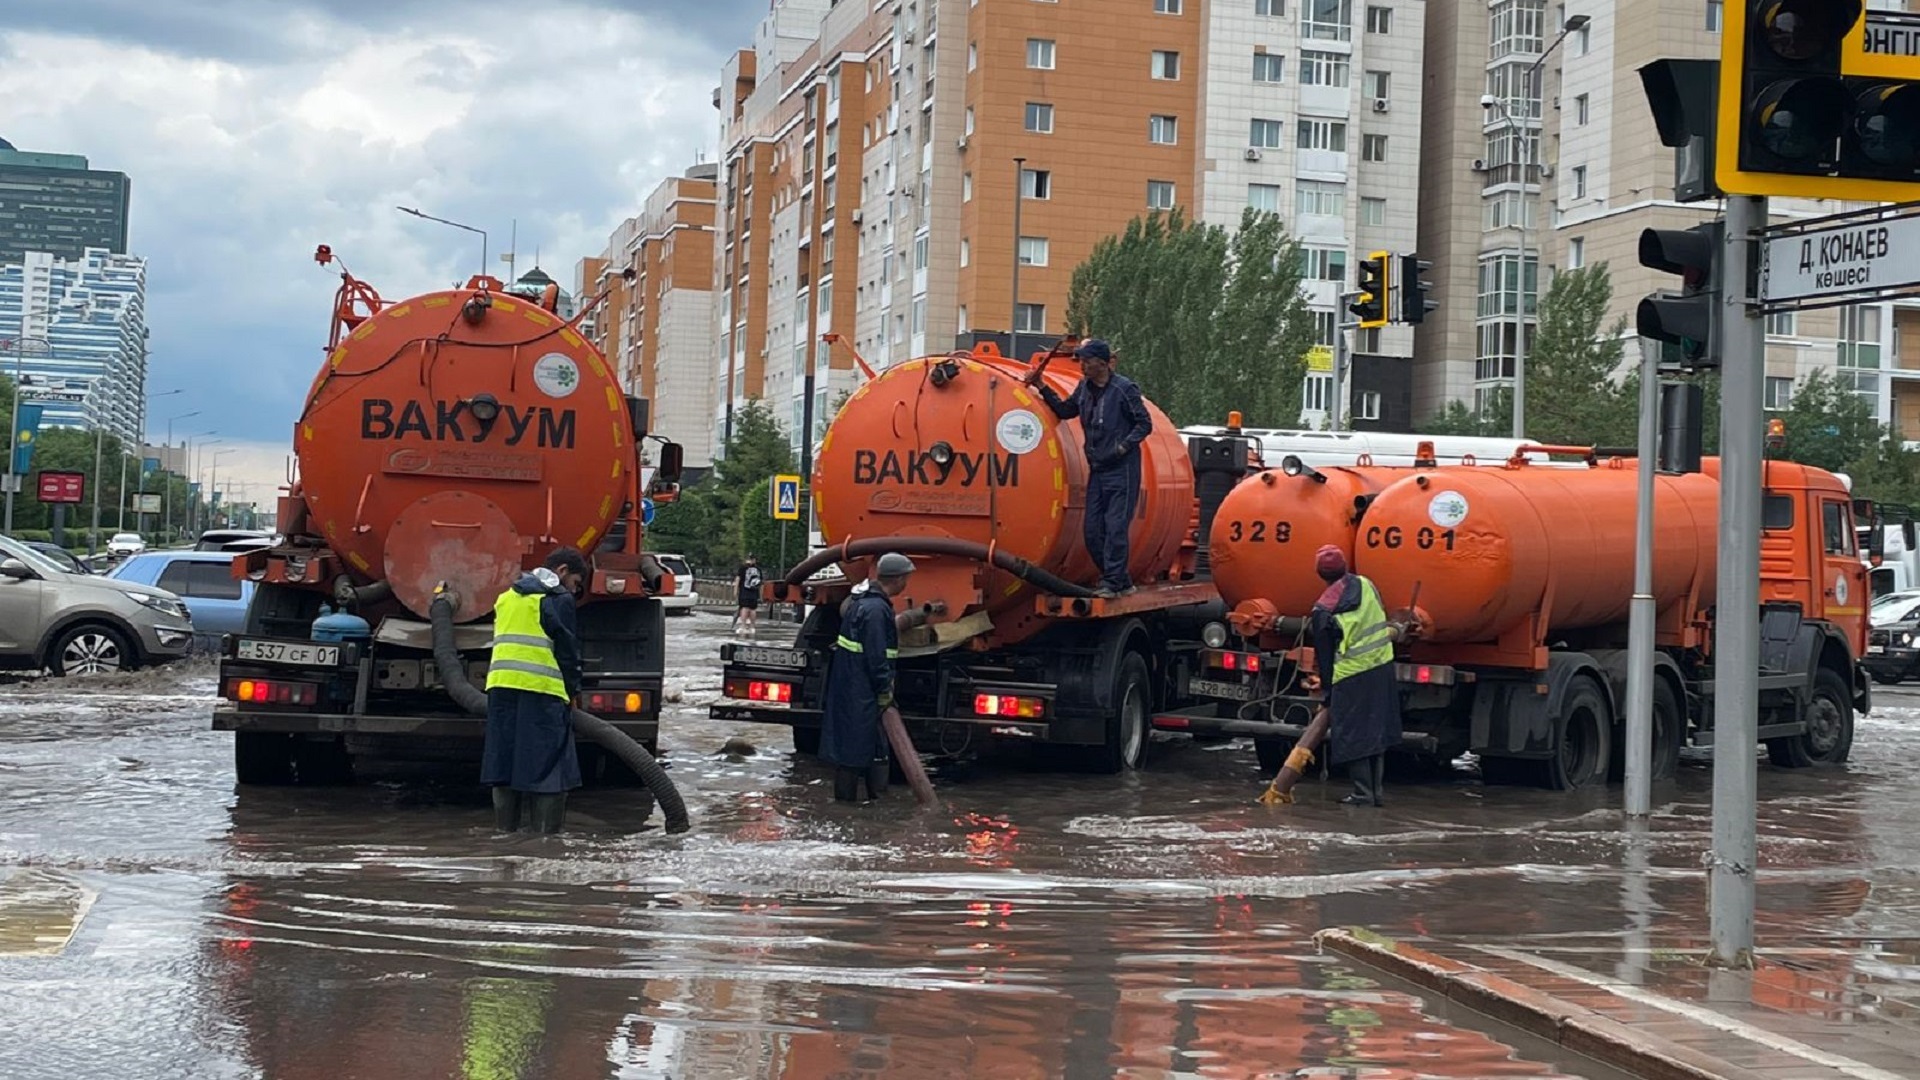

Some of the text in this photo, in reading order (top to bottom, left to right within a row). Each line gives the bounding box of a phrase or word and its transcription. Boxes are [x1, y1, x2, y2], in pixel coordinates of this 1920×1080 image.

[1800, 227, 1889, 274] Д. ҚОНАЕВ
[1816, 261, 1871, 289] көшесі
[361, 399, 576, 449] ВАКУУМ
[854, 450, 1019, 487] ВАКУУМ
[1367, 526, 1454, 551] CG 01
[255, 643, 287, 660] 537
[290, 650, 309, 661] CF
[317, 648, 337, 664] 01
[791, 652, 806, 666] 01
[1200, 682, 1219, 695] 328
